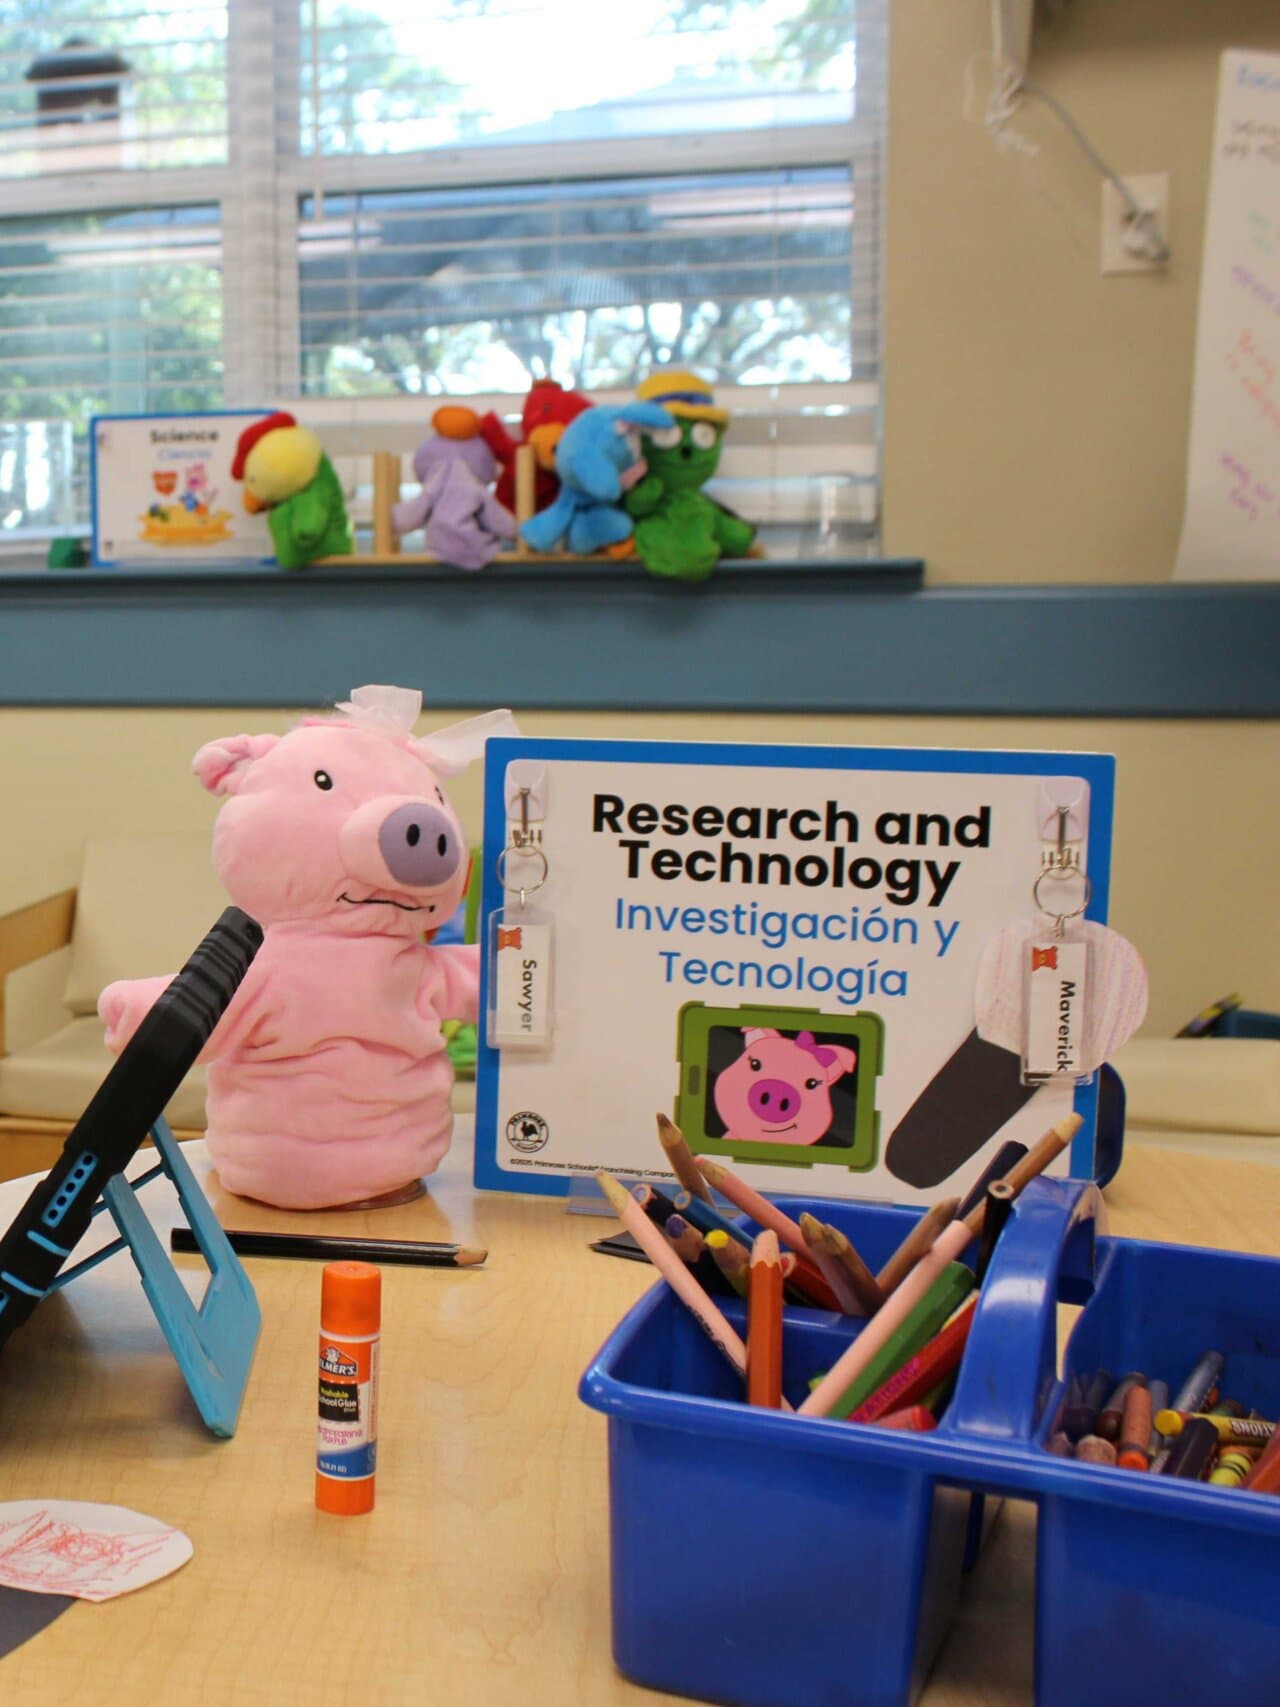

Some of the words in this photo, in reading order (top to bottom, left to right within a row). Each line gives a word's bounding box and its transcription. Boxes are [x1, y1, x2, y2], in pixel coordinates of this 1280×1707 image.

[593, 794, 859, 843] Research
[875, 806, 991, 848] and
[619, 839, 961, 907] Technology
[616, 898, 918, 949] Investigación
[934, 919, 960, 957] y
[517, 959, 537, 1032] Sawyer
[659, 951, 908, 1005] Tecnología
[1056, 980, 1076, 1072] Maverick
